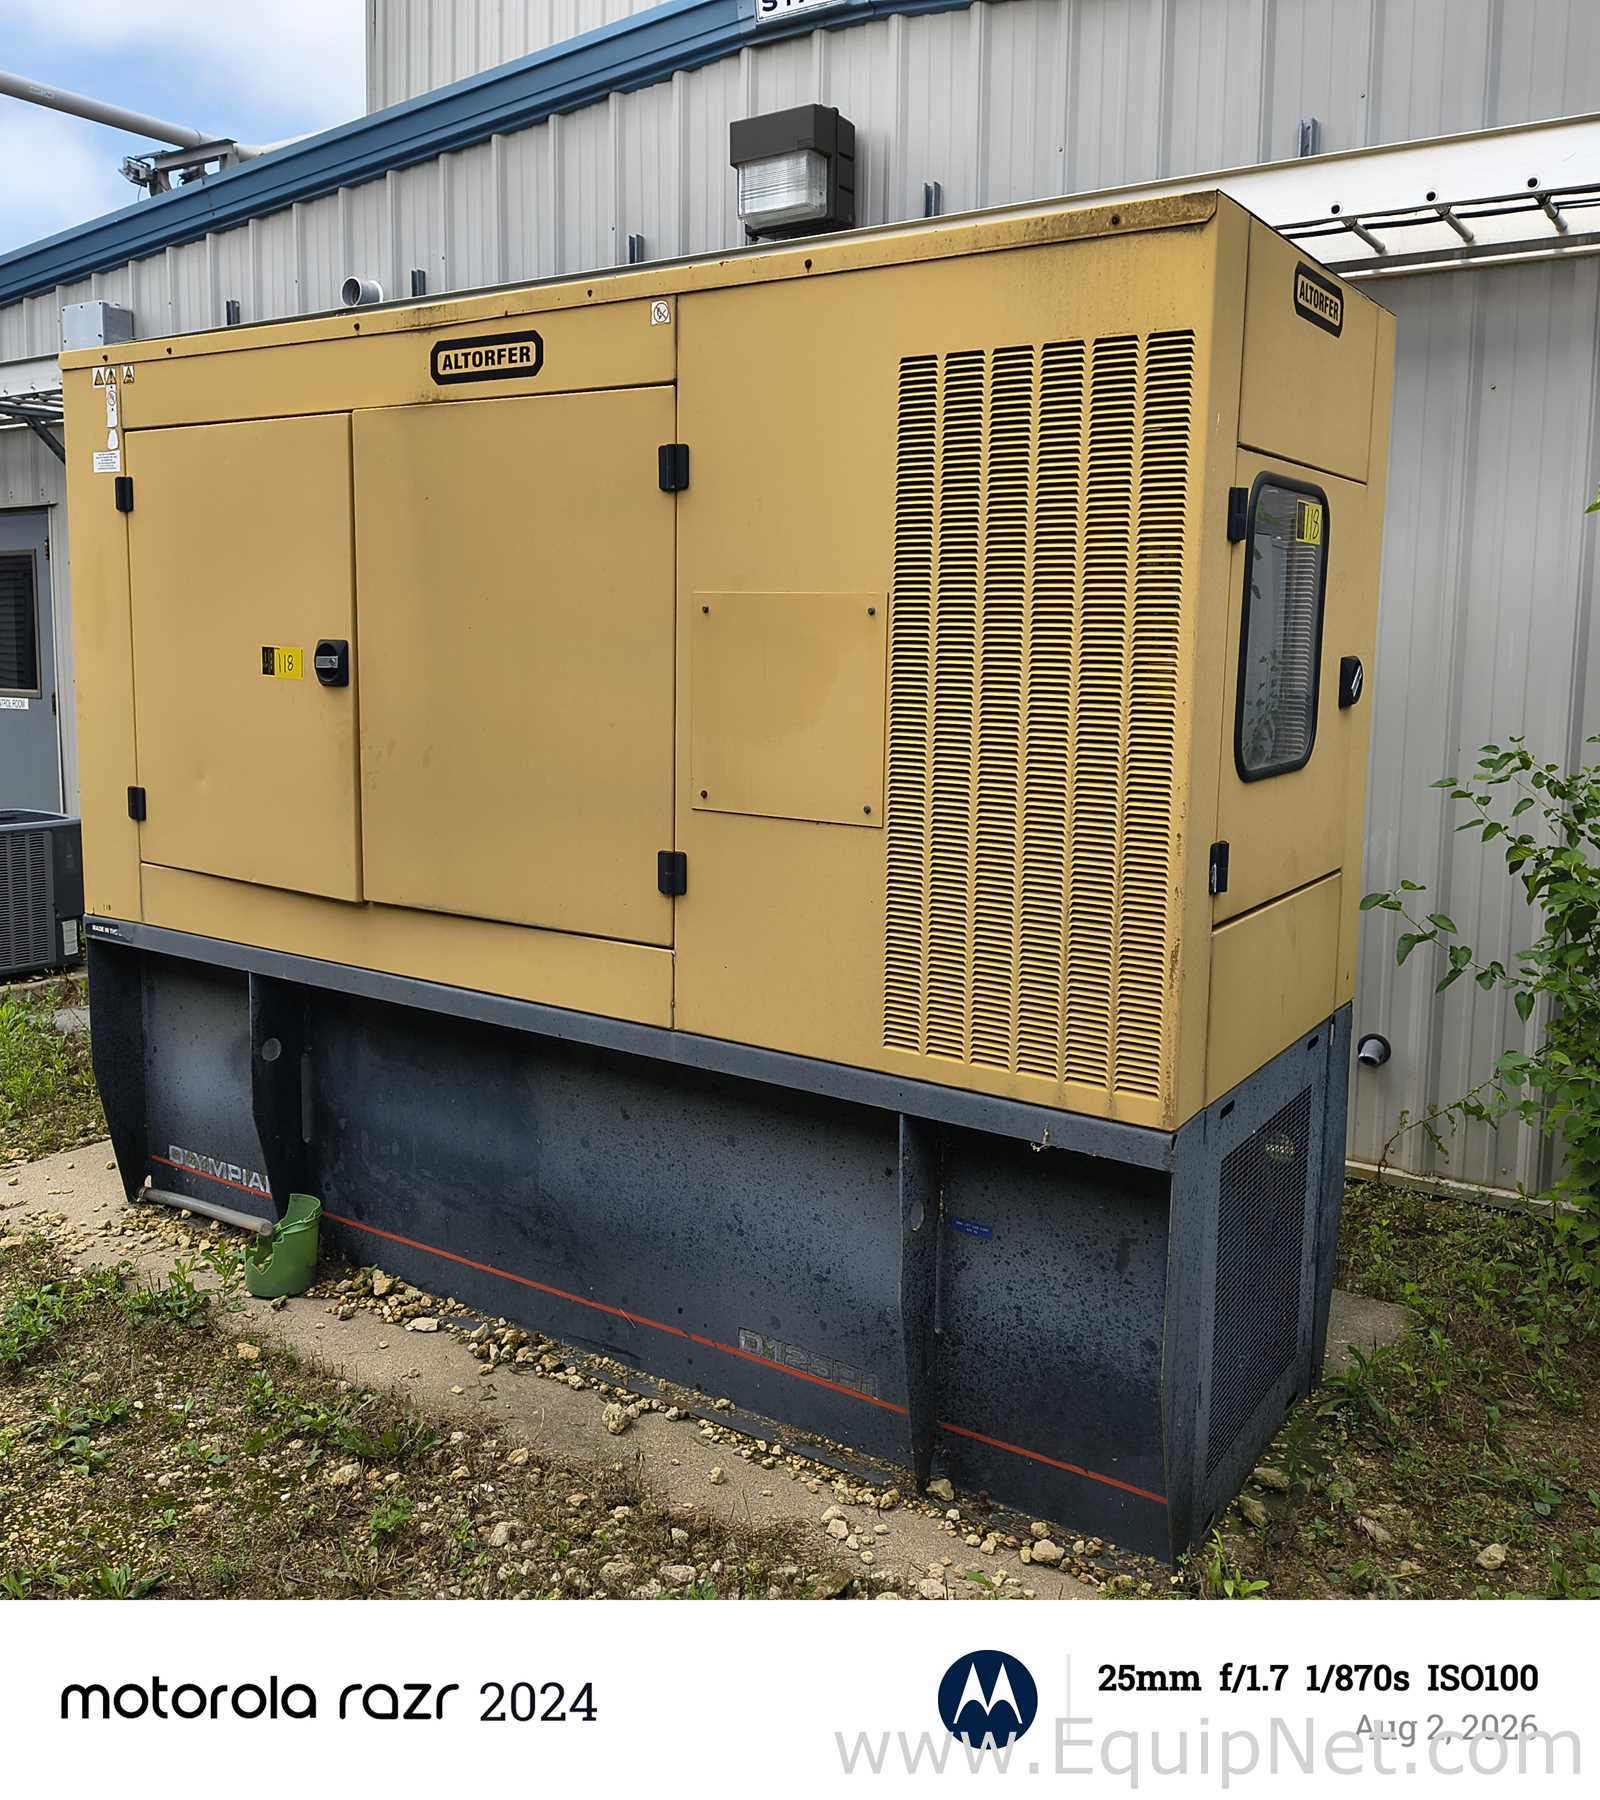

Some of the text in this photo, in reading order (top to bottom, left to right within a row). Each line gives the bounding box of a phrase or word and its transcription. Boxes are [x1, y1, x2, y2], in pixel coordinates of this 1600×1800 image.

[1299, 279, 1340, 322] ALTORFER
[441, 345, 531, 370] ALTORFER
[1304, 508, 1321, 540] 118
[278, 653, 295, 673] 118
